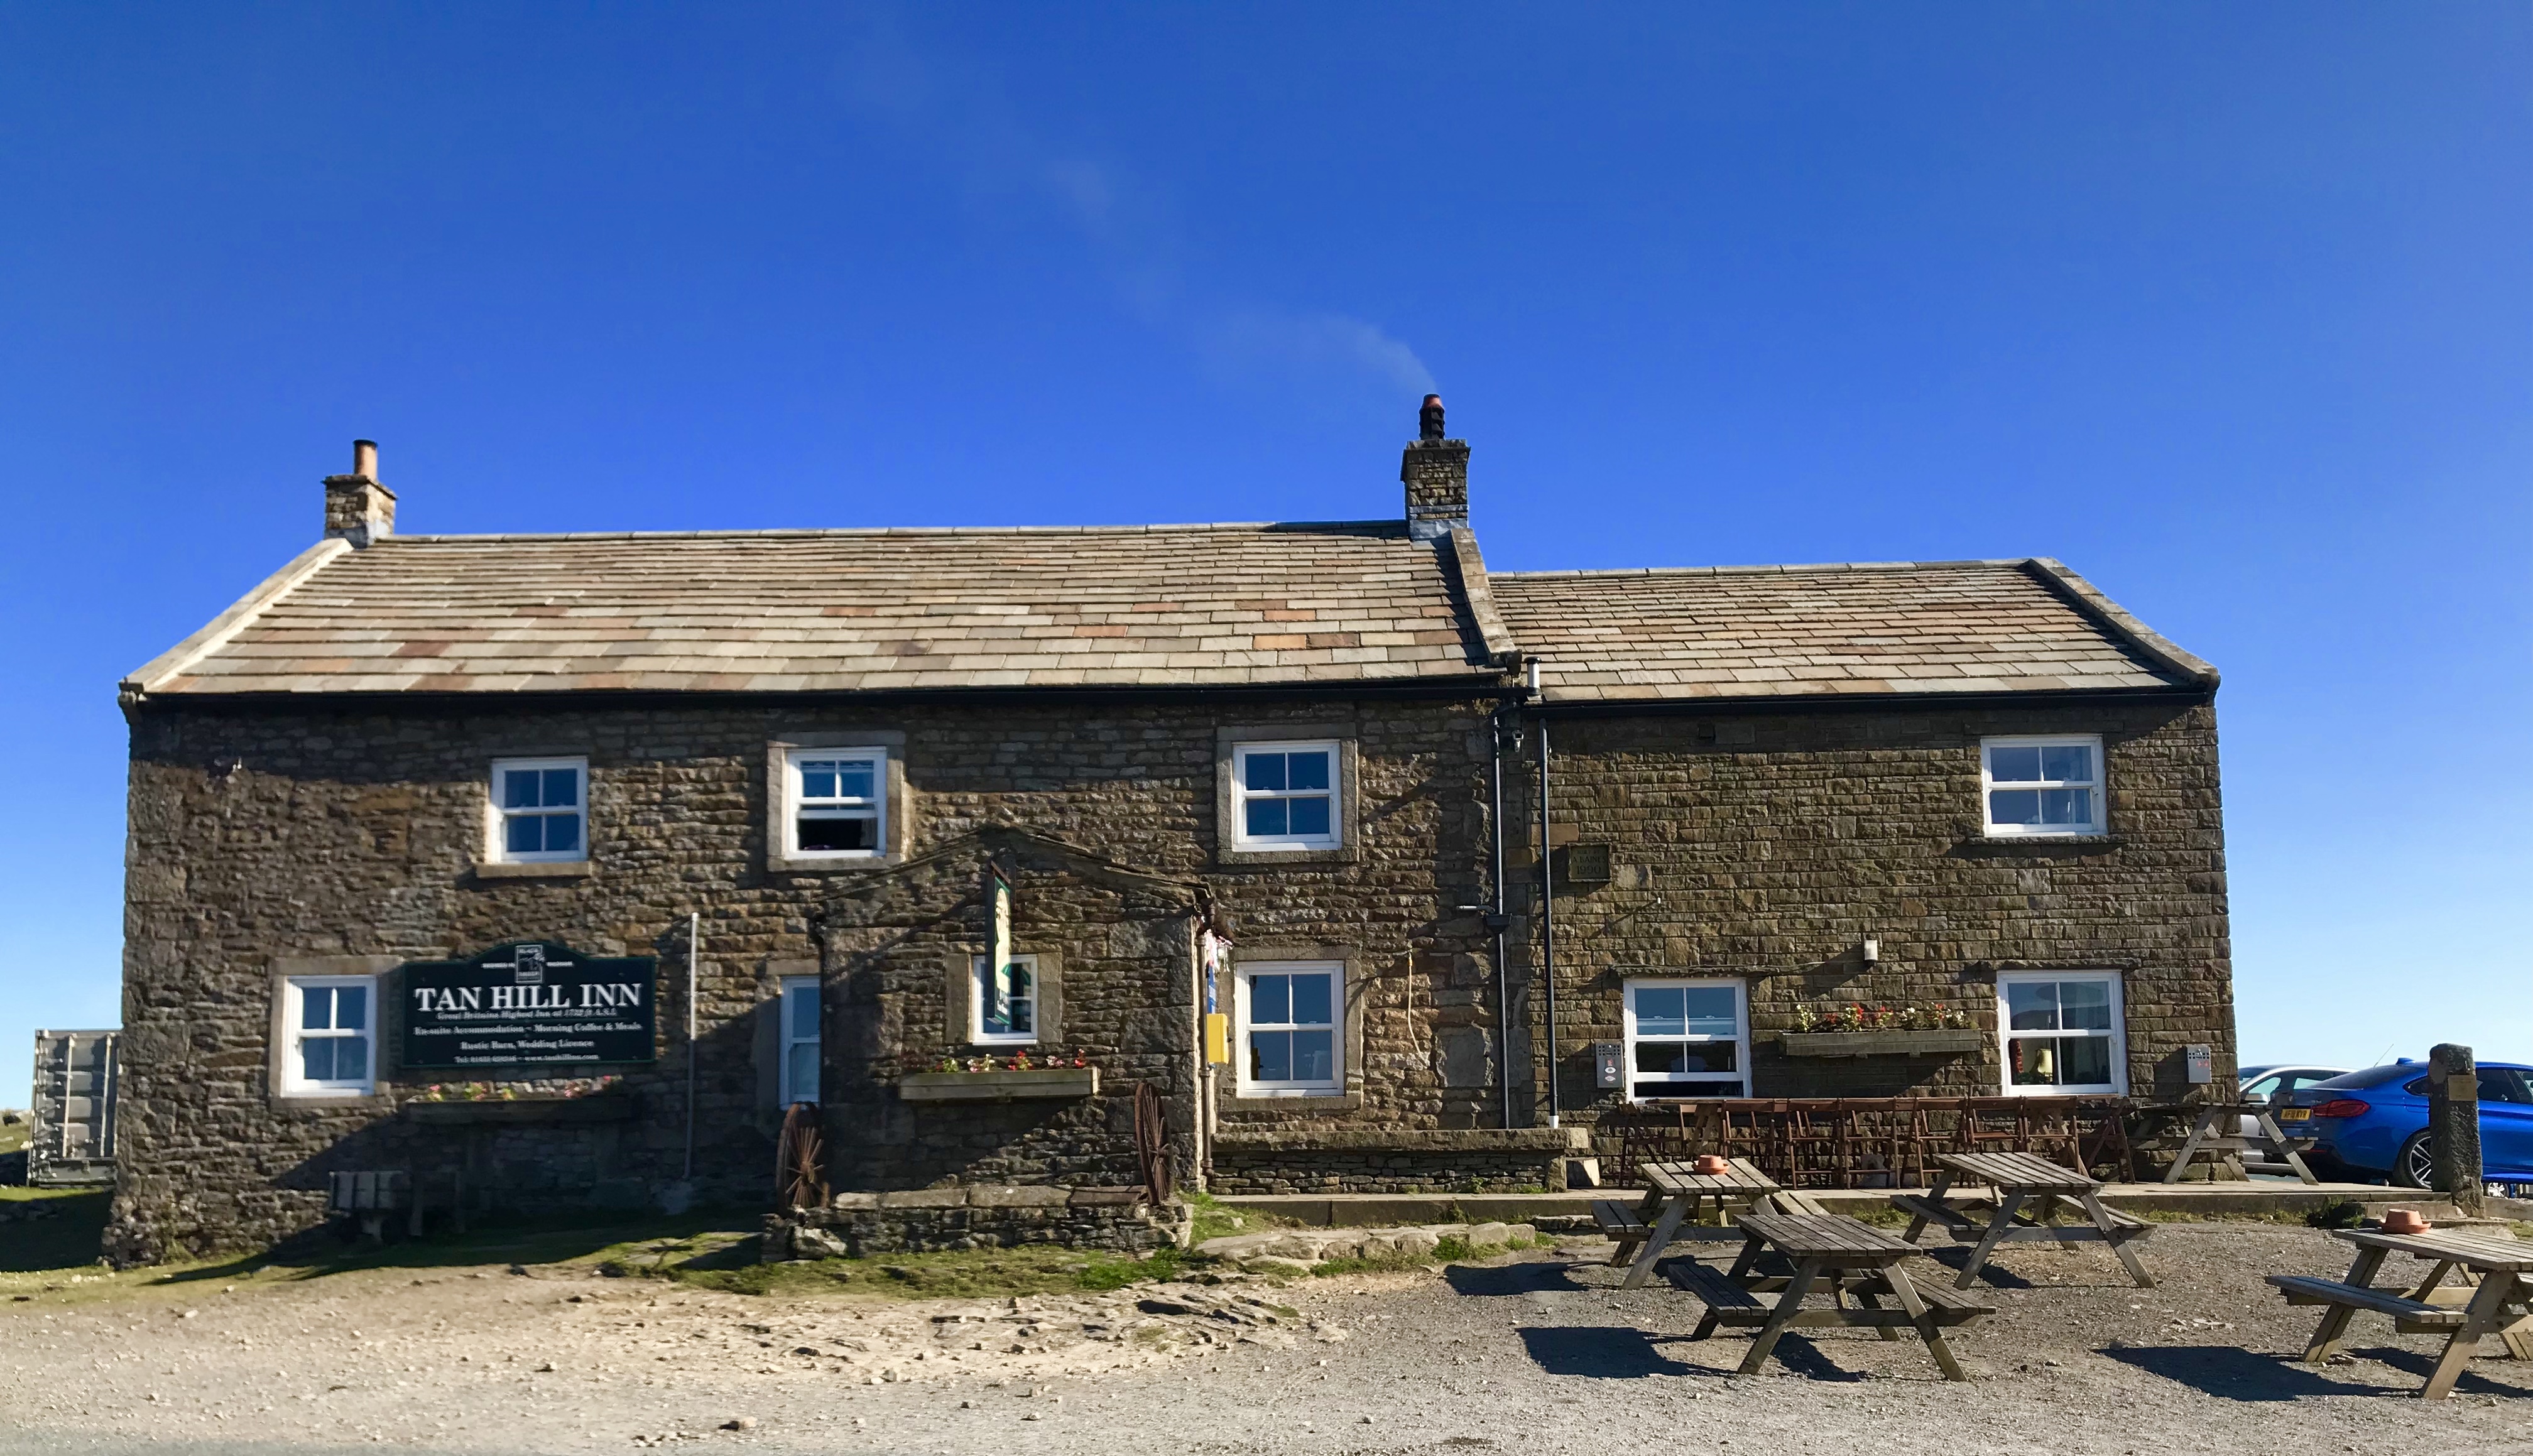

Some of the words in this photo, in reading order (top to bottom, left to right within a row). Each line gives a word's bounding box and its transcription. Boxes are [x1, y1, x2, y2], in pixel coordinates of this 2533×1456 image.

[973, 865, 1577, 875] 1990
[415, 986, 482, 1011] TAN
[490, 984, 570, 1009] HILL
[579, 982, 643, 1008] INN
[535, 1009, 551, 1018] Inn
[453, 1025, 525, 1035] Accommodation
[533, 1024, 574, 1033] Morning
[574, 1023, 604, 1032] Coffee
[604, 1023, 614, 1031] &
[615, 1021, 643, 1031] Meals
[459, 1041, 490, 1050] Rustic
[516, 1039, 558, 1049] Wedding
